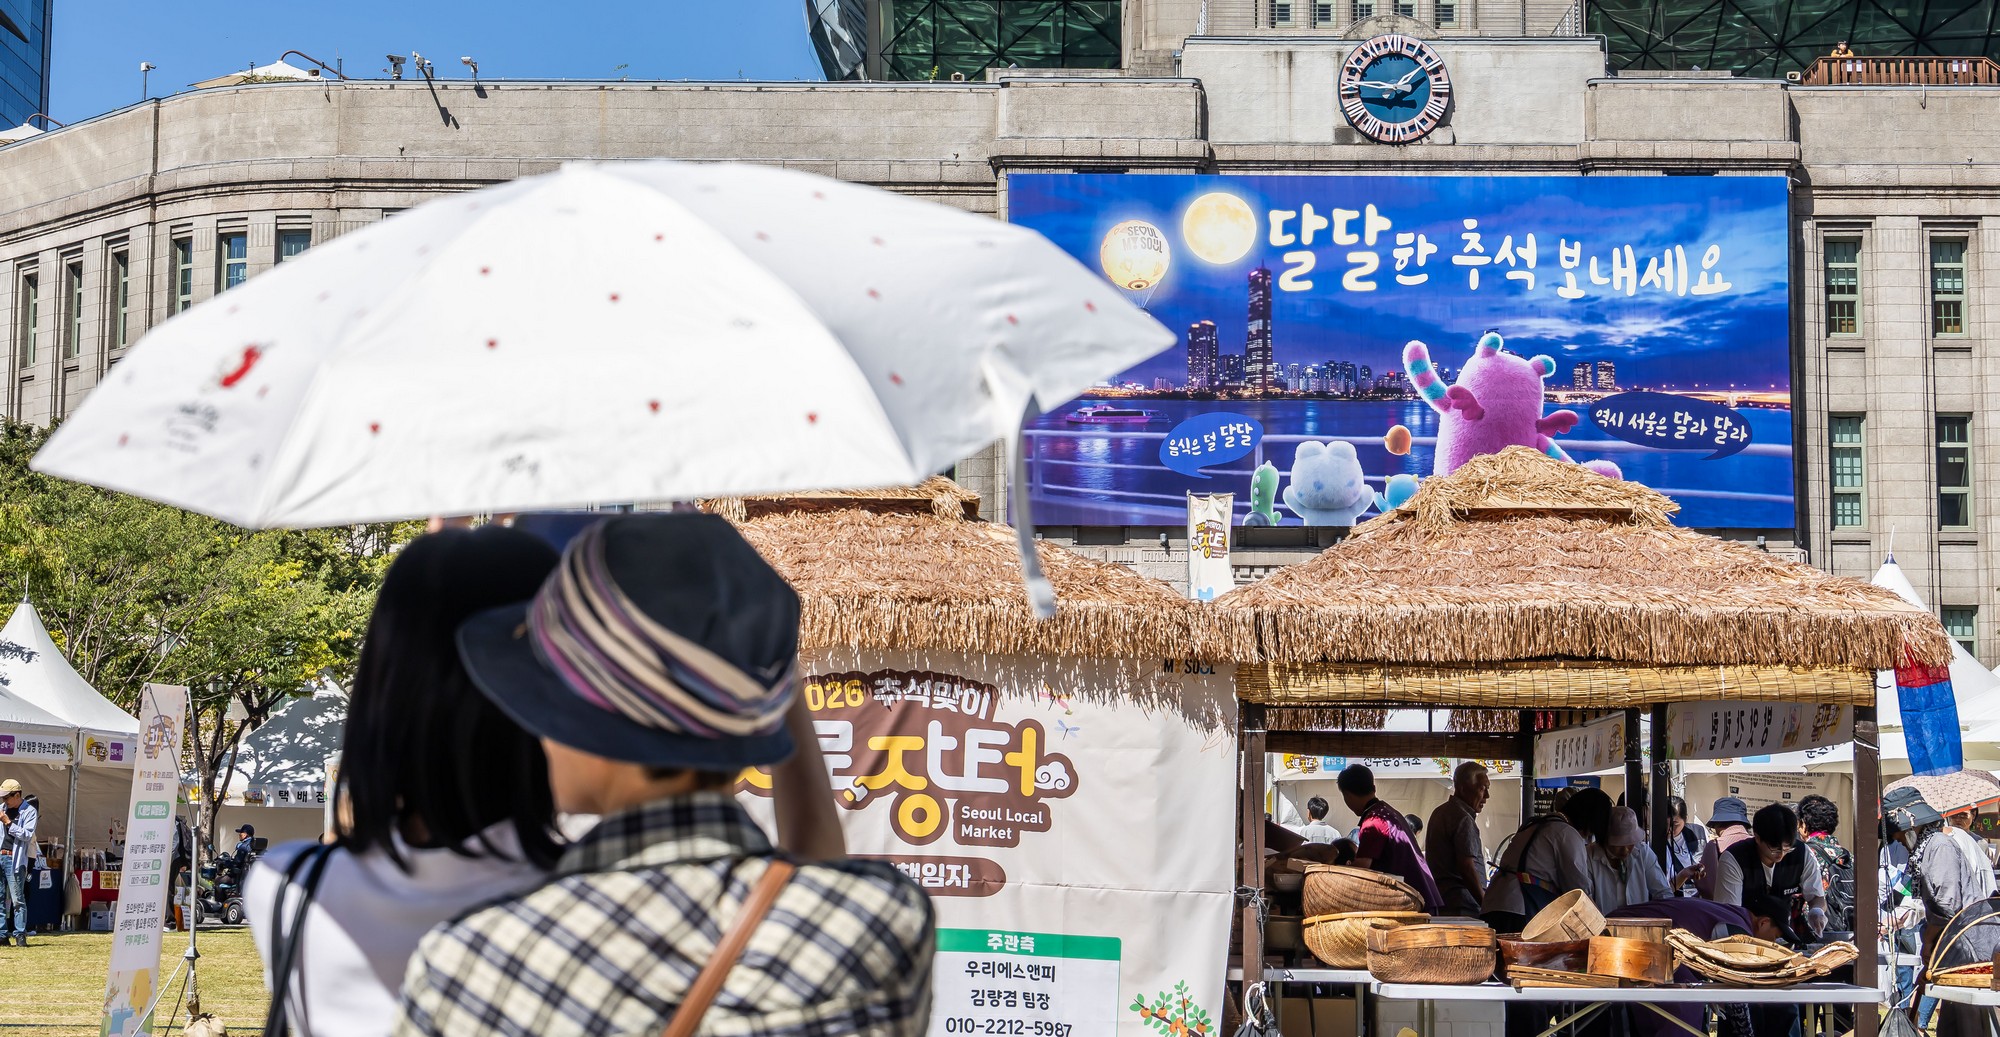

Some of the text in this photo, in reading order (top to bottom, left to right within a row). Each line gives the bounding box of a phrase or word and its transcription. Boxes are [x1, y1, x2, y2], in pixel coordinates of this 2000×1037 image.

[1269, 202, 1733, 299] 달달한 추석 보내세요
[1596, 408, 1748, 444] 역시 서울은 달라 달라
[1168, 422, 1253, 457] 음식은 덜 달달
[804, 677, 990, 719] 026 추석맞이
[961, 806, 1044, 824] Seoul Local
[961, 824, 1012, 839] Market
[892, 862, 972, 888] 책임자
[1784, 887, 1799, 896] STAFF
[987, 934, 1035, 953] 주관측
[965, 960, 1056, 983] 우리에스앤피
[970, 989, 1051, 1011] 김량겸 팀장
[946, 1017, 1073, 1037] 010-2212-5987
